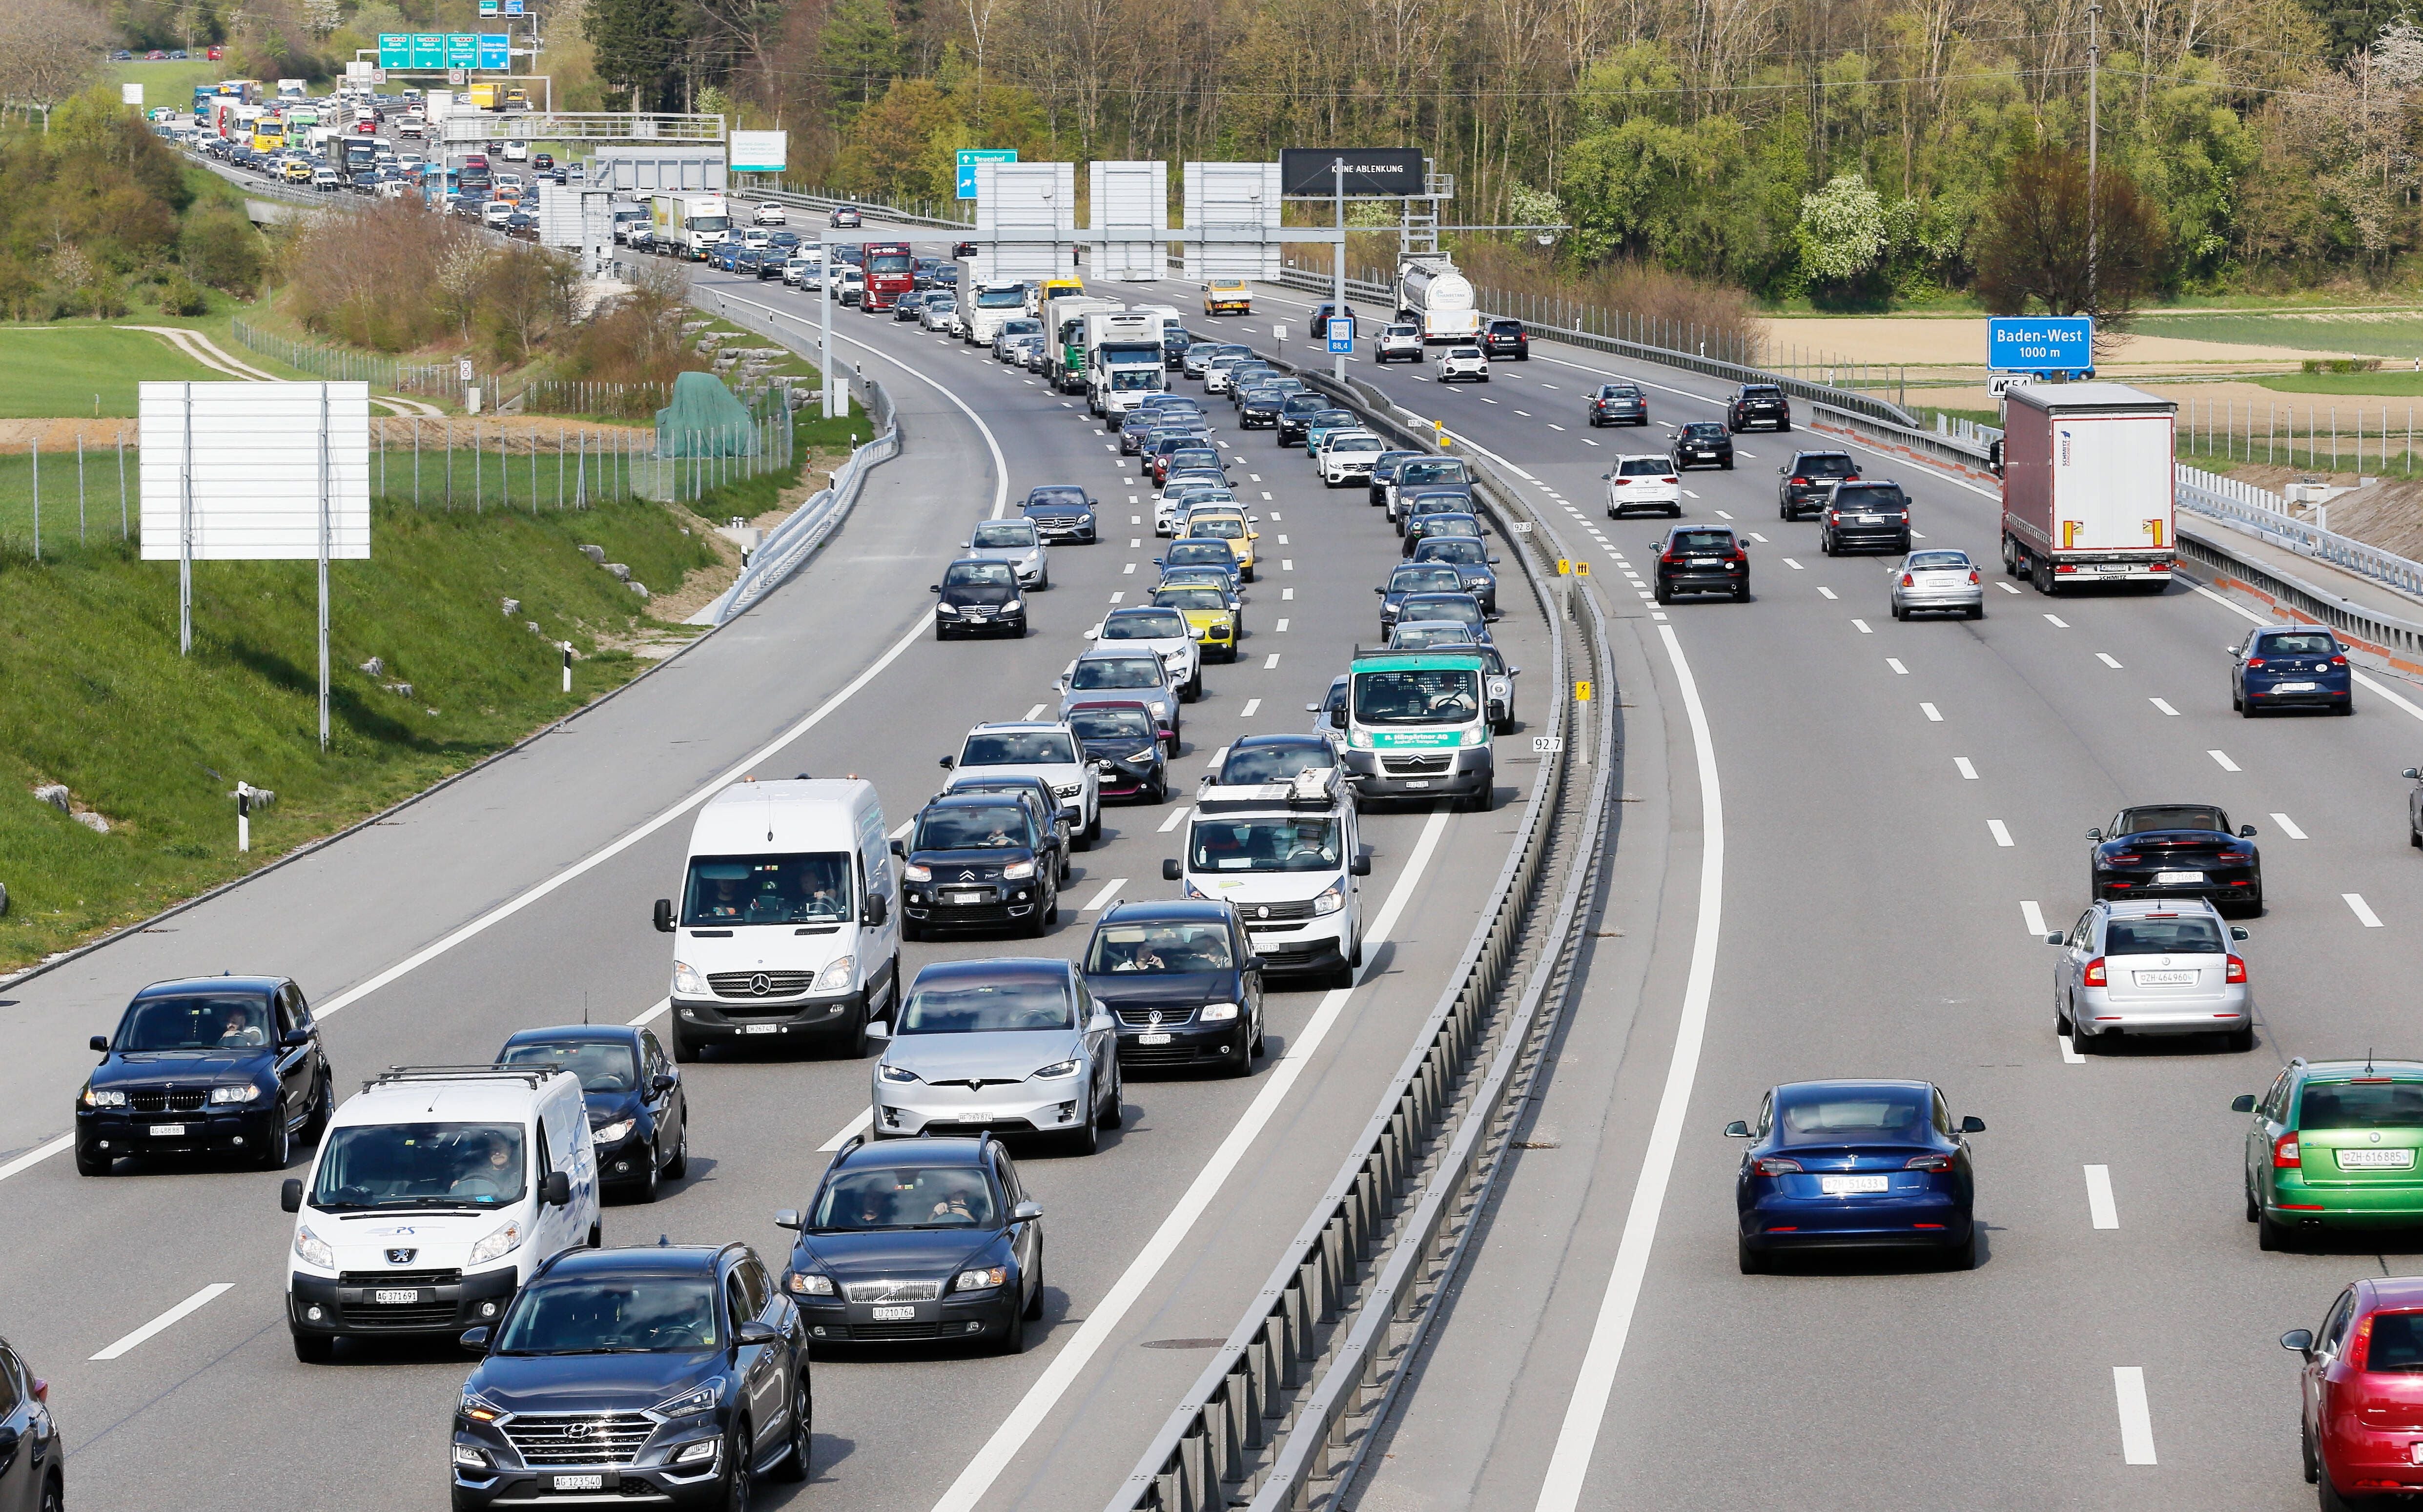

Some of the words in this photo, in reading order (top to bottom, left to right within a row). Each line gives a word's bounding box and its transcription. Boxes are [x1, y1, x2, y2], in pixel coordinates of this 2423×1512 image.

[1997, 329, 2082, 342] Baden-West
[1333, 342, 1348, 350] 88,4
[2020, 347, 2046, 358] 1000
[2050, 349, 2060, 358] m
[1535, 739, 1560, 750] 92.7
